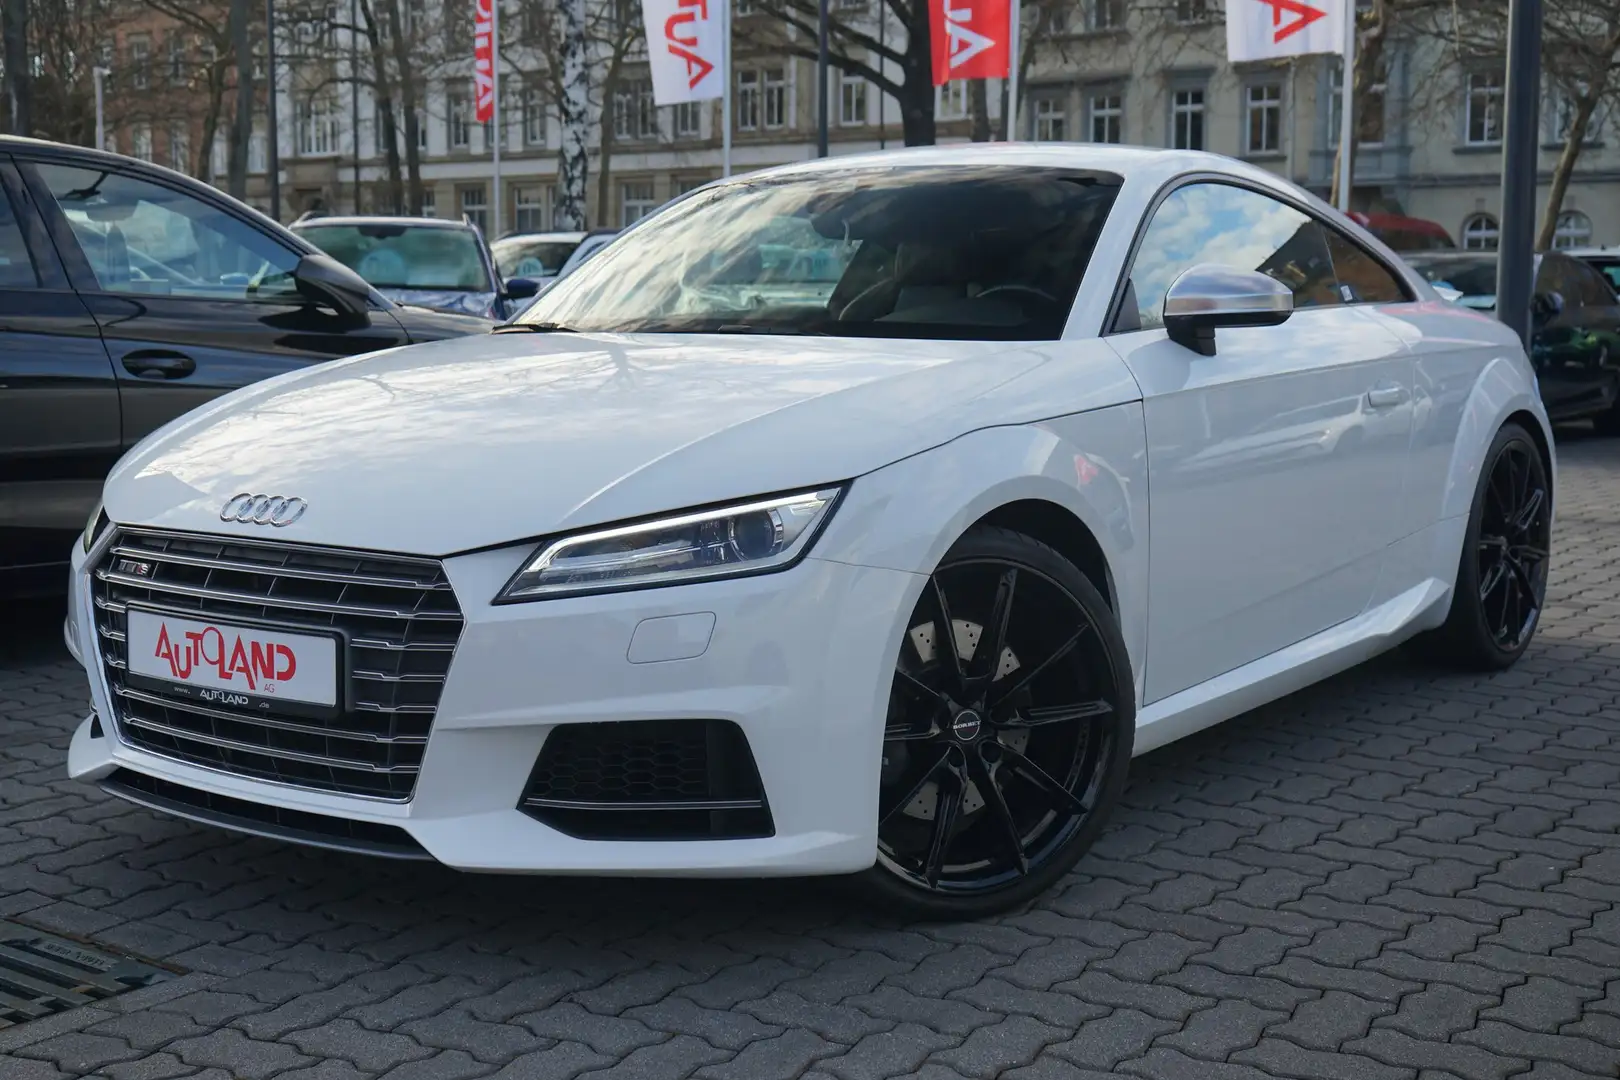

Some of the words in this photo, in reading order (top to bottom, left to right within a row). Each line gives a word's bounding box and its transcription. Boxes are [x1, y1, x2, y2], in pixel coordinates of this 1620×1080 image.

[154, 621, 297, 691] AUTOLAND
[263, 683, 275, 694] AG
[199, 689, 249, 706] AUTOLAND
